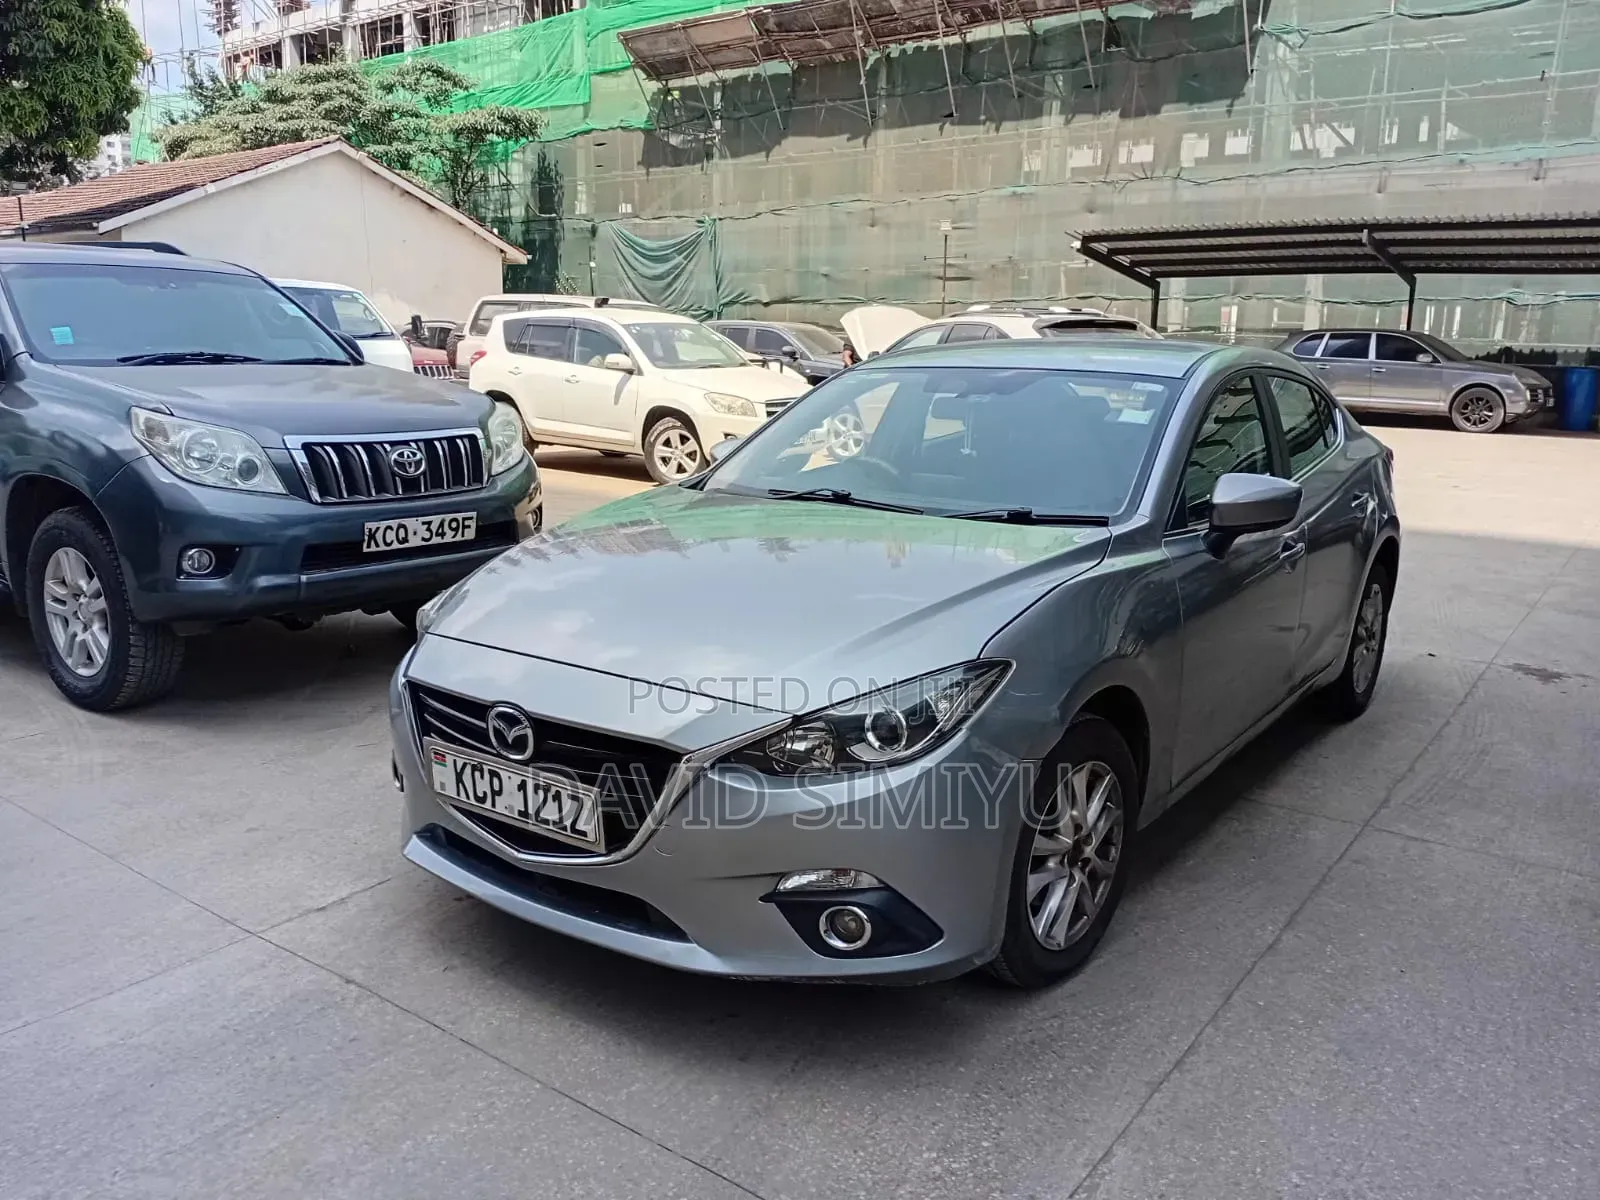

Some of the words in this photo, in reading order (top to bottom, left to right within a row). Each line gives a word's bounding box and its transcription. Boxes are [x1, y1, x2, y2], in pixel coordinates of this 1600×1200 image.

[366, 523, 410, 549] KCQ
[421, 516, 474, 543] 349F
[453, 758, 503, 809] KCP
[517, 779, 588, 838] 121Z
